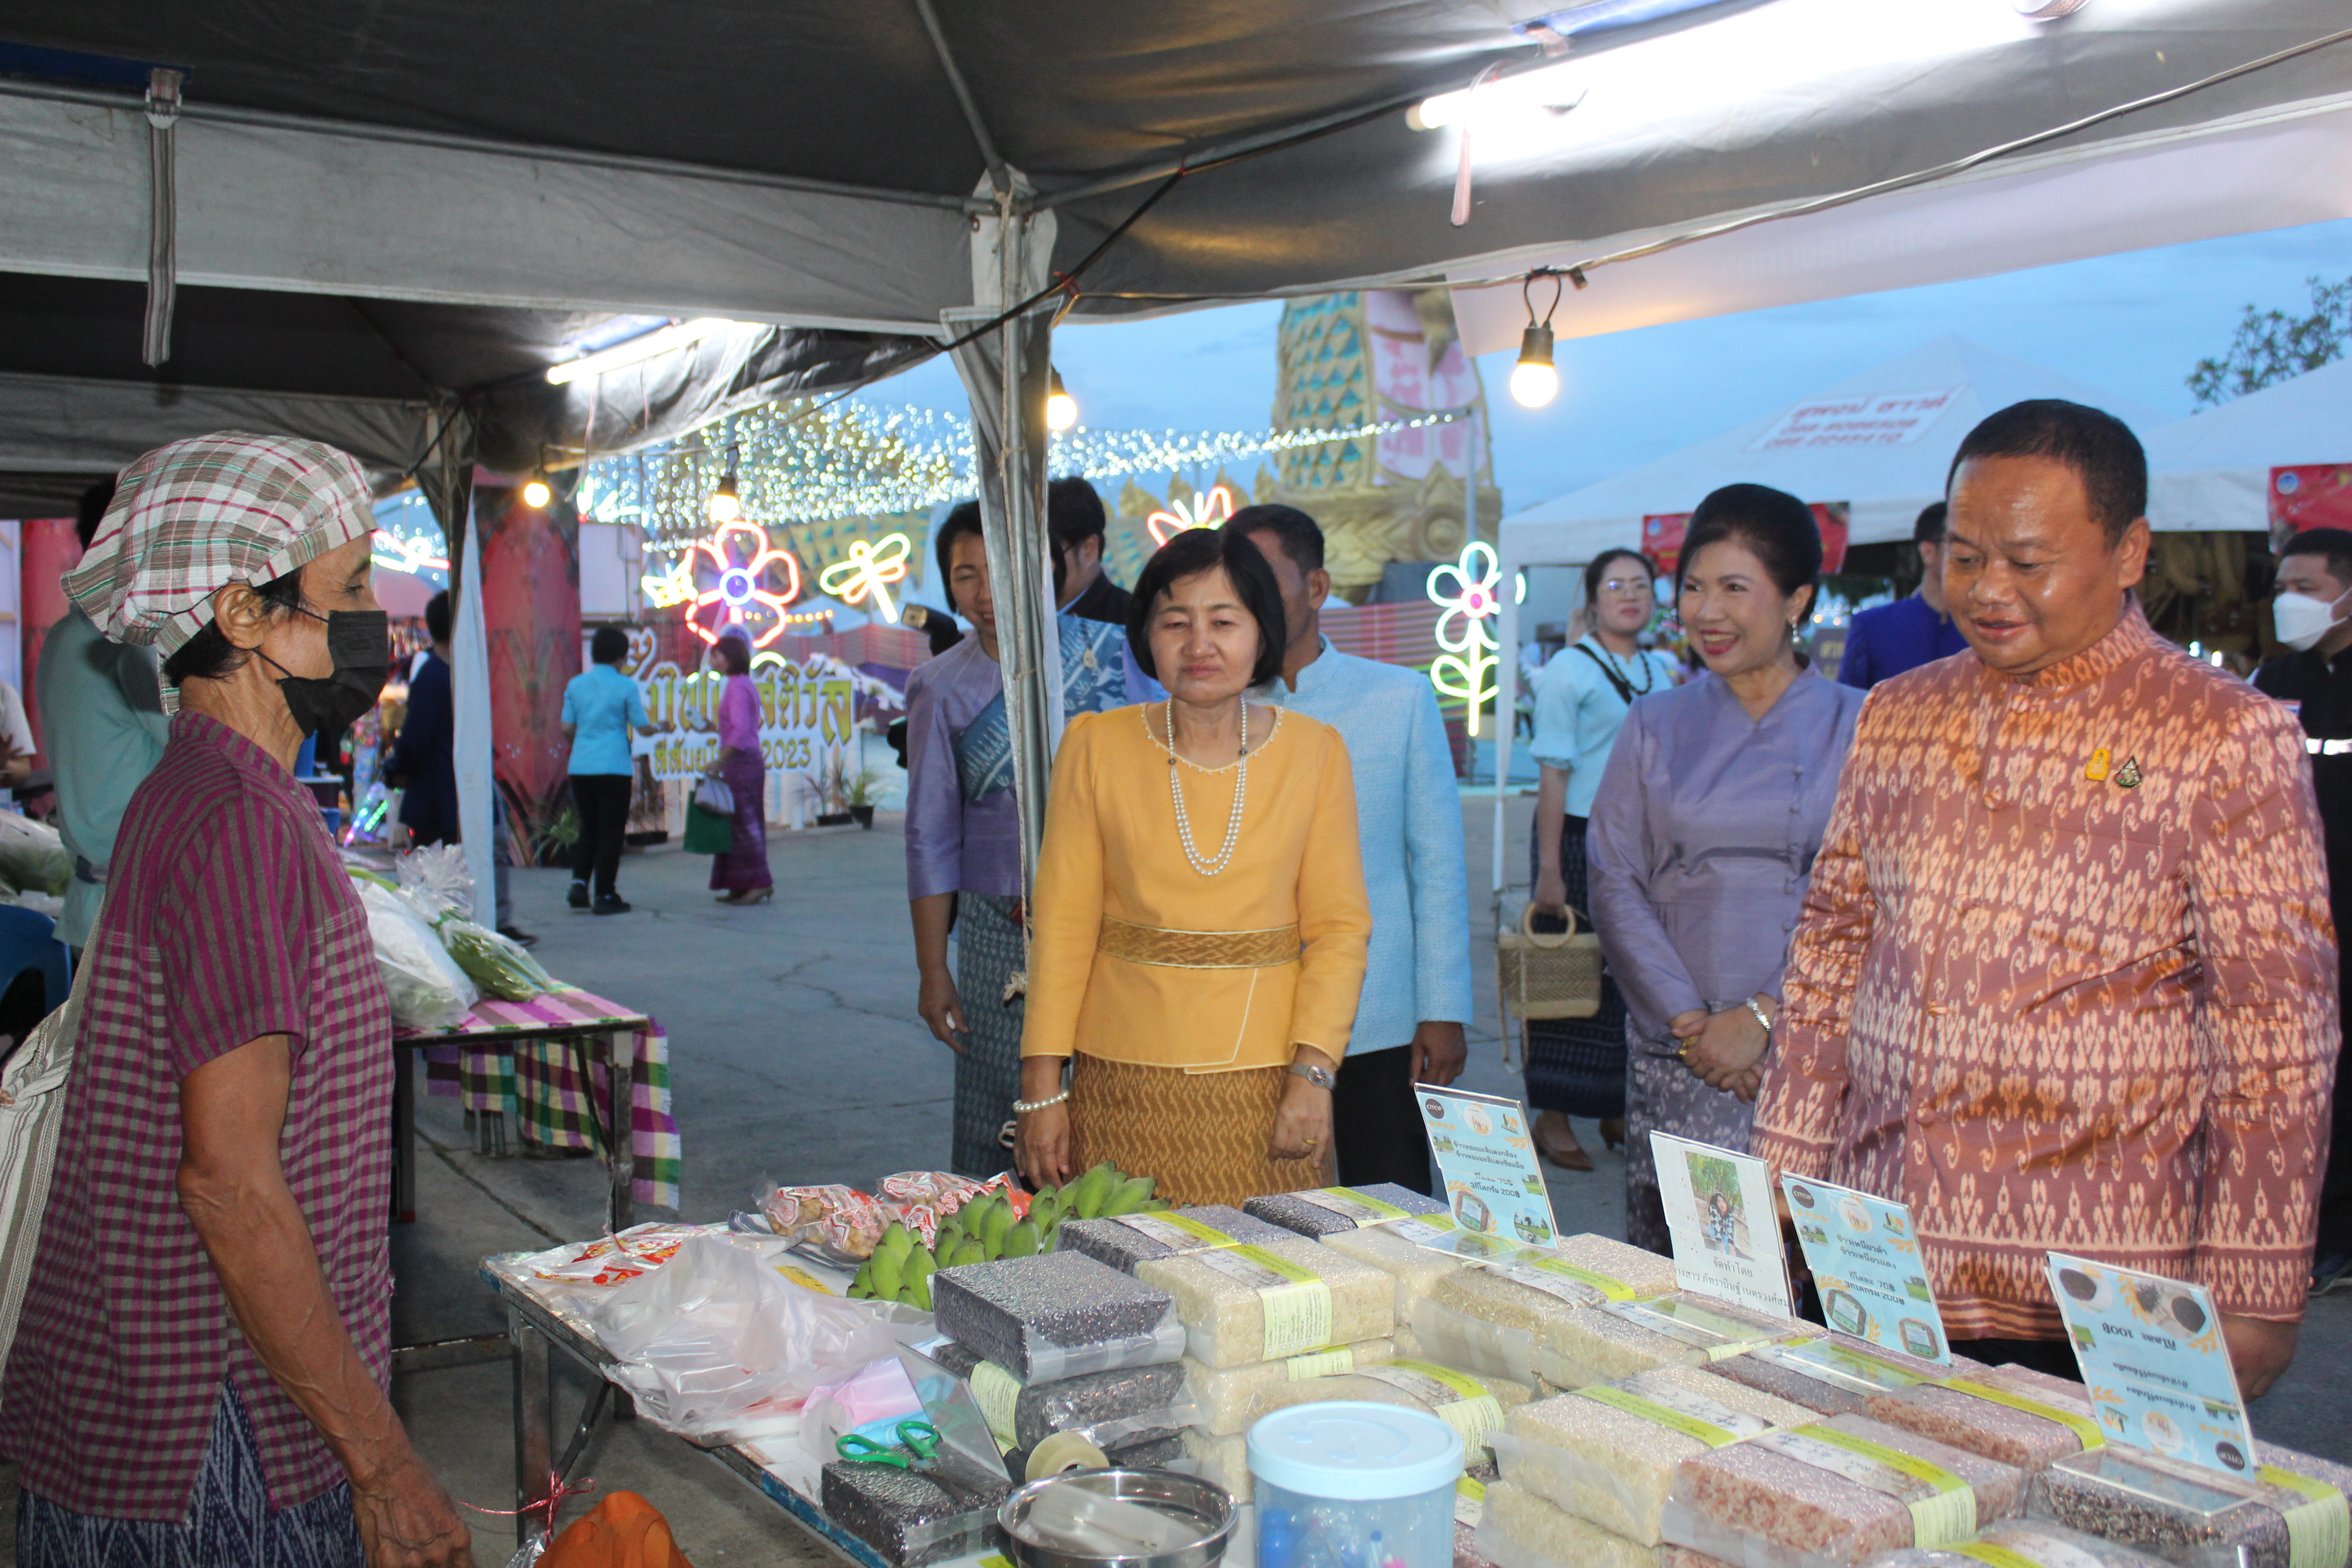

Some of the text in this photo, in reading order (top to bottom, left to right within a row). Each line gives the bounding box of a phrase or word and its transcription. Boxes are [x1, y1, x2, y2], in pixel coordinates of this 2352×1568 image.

[761, 738, 811, 769] 2023
[1793, 1191, 1812, 1200] OTOP
[1837, 1233, 1887, 1255] ข้าวเหนียวดำ
[1713, 1256, 1753, 1278] จัดทำโดย
[1840, 1246, 1896, 1269] ข้าวเหนียวแดง
